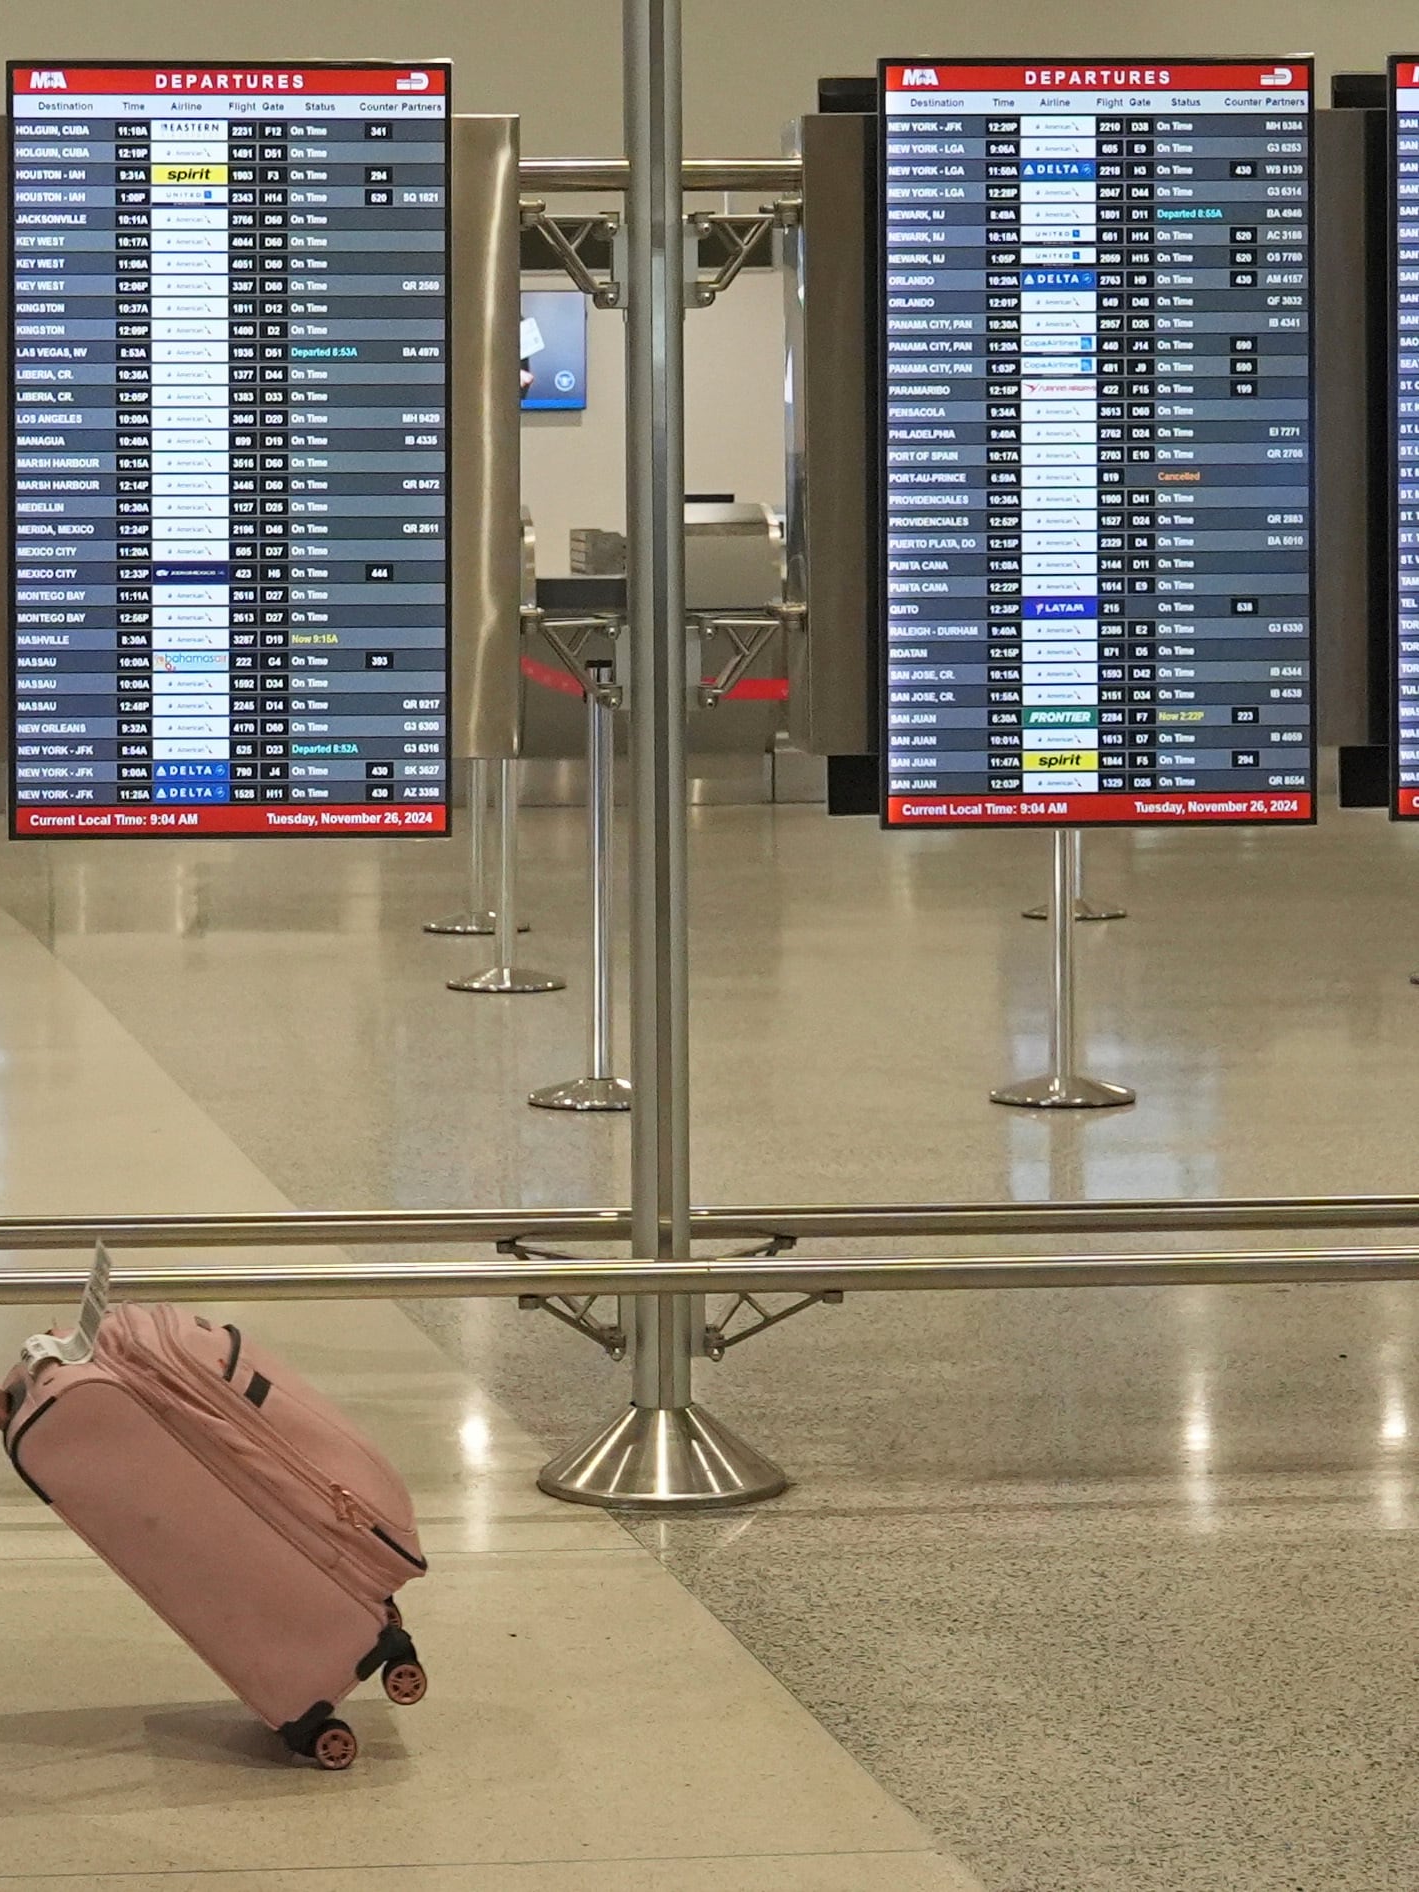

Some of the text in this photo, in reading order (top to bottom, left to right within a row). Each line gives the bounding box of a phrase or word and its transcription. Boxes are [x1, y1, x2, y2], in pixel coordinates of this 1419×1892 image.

[156, 74, 303, 89] DEPARTURES
[1025, 71, 1169, 85] DEPARTURES
[38, 102, 442, 113] Destination Time Airline Flight Gate Status Counter Partners
[910, 98, 1305, 109] Destination Time Airline Flight Gate Status Counter Partners
[170, 123, 219, 132] EASTERN
[913, 122, 938, 131] YORK
[16, 168, 211, 182] HOUSTON spirit
[16, 215, 87, 224] JACKSONVILLE
[1157, 209, 1196, 220] Departed
[1038, 274, 1079, 283] DELTA
[888, 298, 935, 307] ORLANDO
[16, 303, 65, 313] KINGSTON
[291, 348, 331, 358] Departed
[889, 364, 927, 373] PANAMA
[889, 386, 950, 395] PARAMARIBO
[889, 408, 945, 417] PENSACOLA
[17, 414, 82, 424] LOS ANGELES
[889, 430, 955, 439] PHILADELPHIA
[17, 437, 65, 446] MANAGUA
[890, 452, 958, 461] PORT OF SPAIN
[17, 458, 99, 468] MARSH HARBOUR
[889, 472, 1200, 483] PORT-AU-PRINCE Cancelled
[889, 495, 969, 505] PROVIDENCIALES
[17, 503, 64, 512] MEDELLIN
[890, 539, 927, 550] PUERTO
[17, 547, 54, 556] MEXICO
[890, 561, 948, 571] PUNTA CANA
[18, 591, 85, 600] MONTEGO BAY
[890, 604, 1084, 615] QUITO LATAM
[890, 626, 978, 637] RALEIGH DURHAM
[18, 636, 69, 645] NASHVILLE
[889, 649, 927, 658] ROATAN
[18, 658, 57, 667] NASSAU
[1029, 712, 1091, 723] FRONTIER
[18, 724, 86, 733] NEW ORLEANS
[1039, 754, 1081, 768] spirit
[891, 780, 937, 790] SAN JUAN
[170, 788, 212, 797] DELTA
[902, 800, 1298, 815] Current Local Time: 9:04 AM Tuesday, November 26, 2024
[30, 812, 432, 827] Current Local Time: 9:04 AM Tuesday, November 26, 2024
